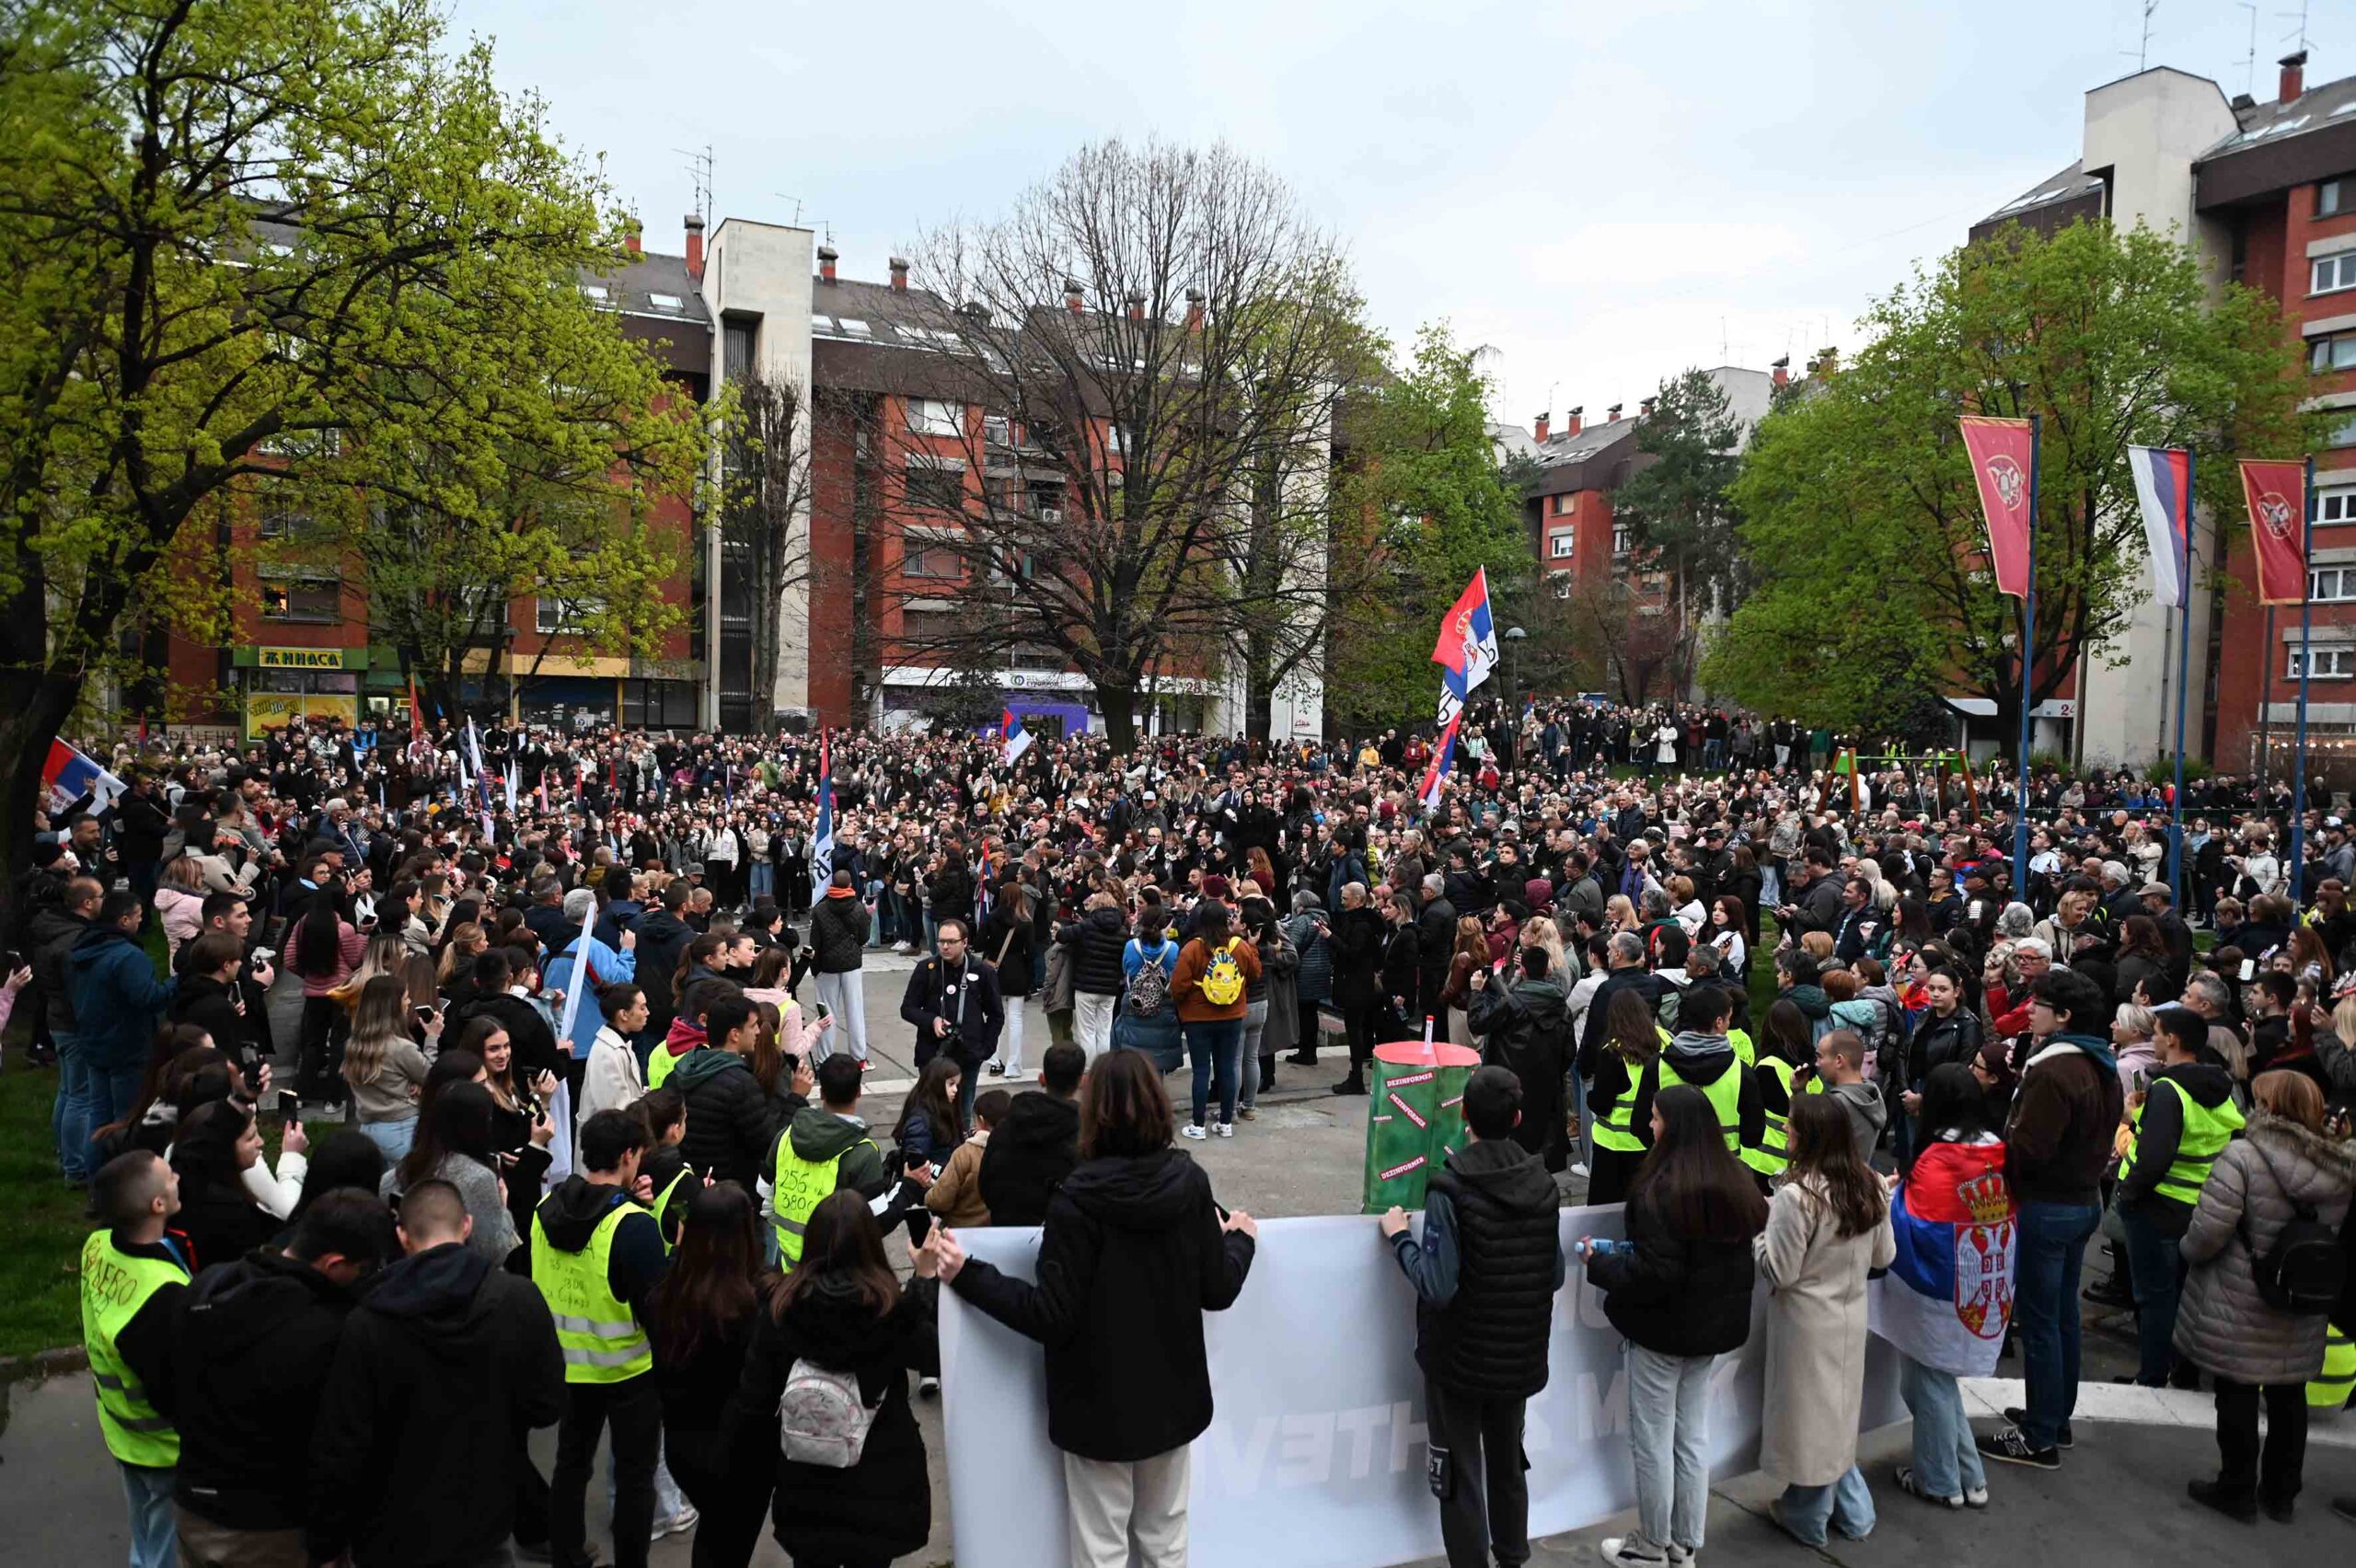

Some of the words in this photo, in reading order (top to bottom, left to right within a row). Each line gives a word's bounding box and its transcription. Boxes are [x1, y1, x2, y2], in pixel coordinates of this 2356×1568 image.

[1187, 682, 1202, 693] 28
[1386, 1072, 1434, 1087] DEZINFORMER
[1380, 1156, 1426, 1180] DEZINFORMER
[780, 1169, 810, 1193] 256
